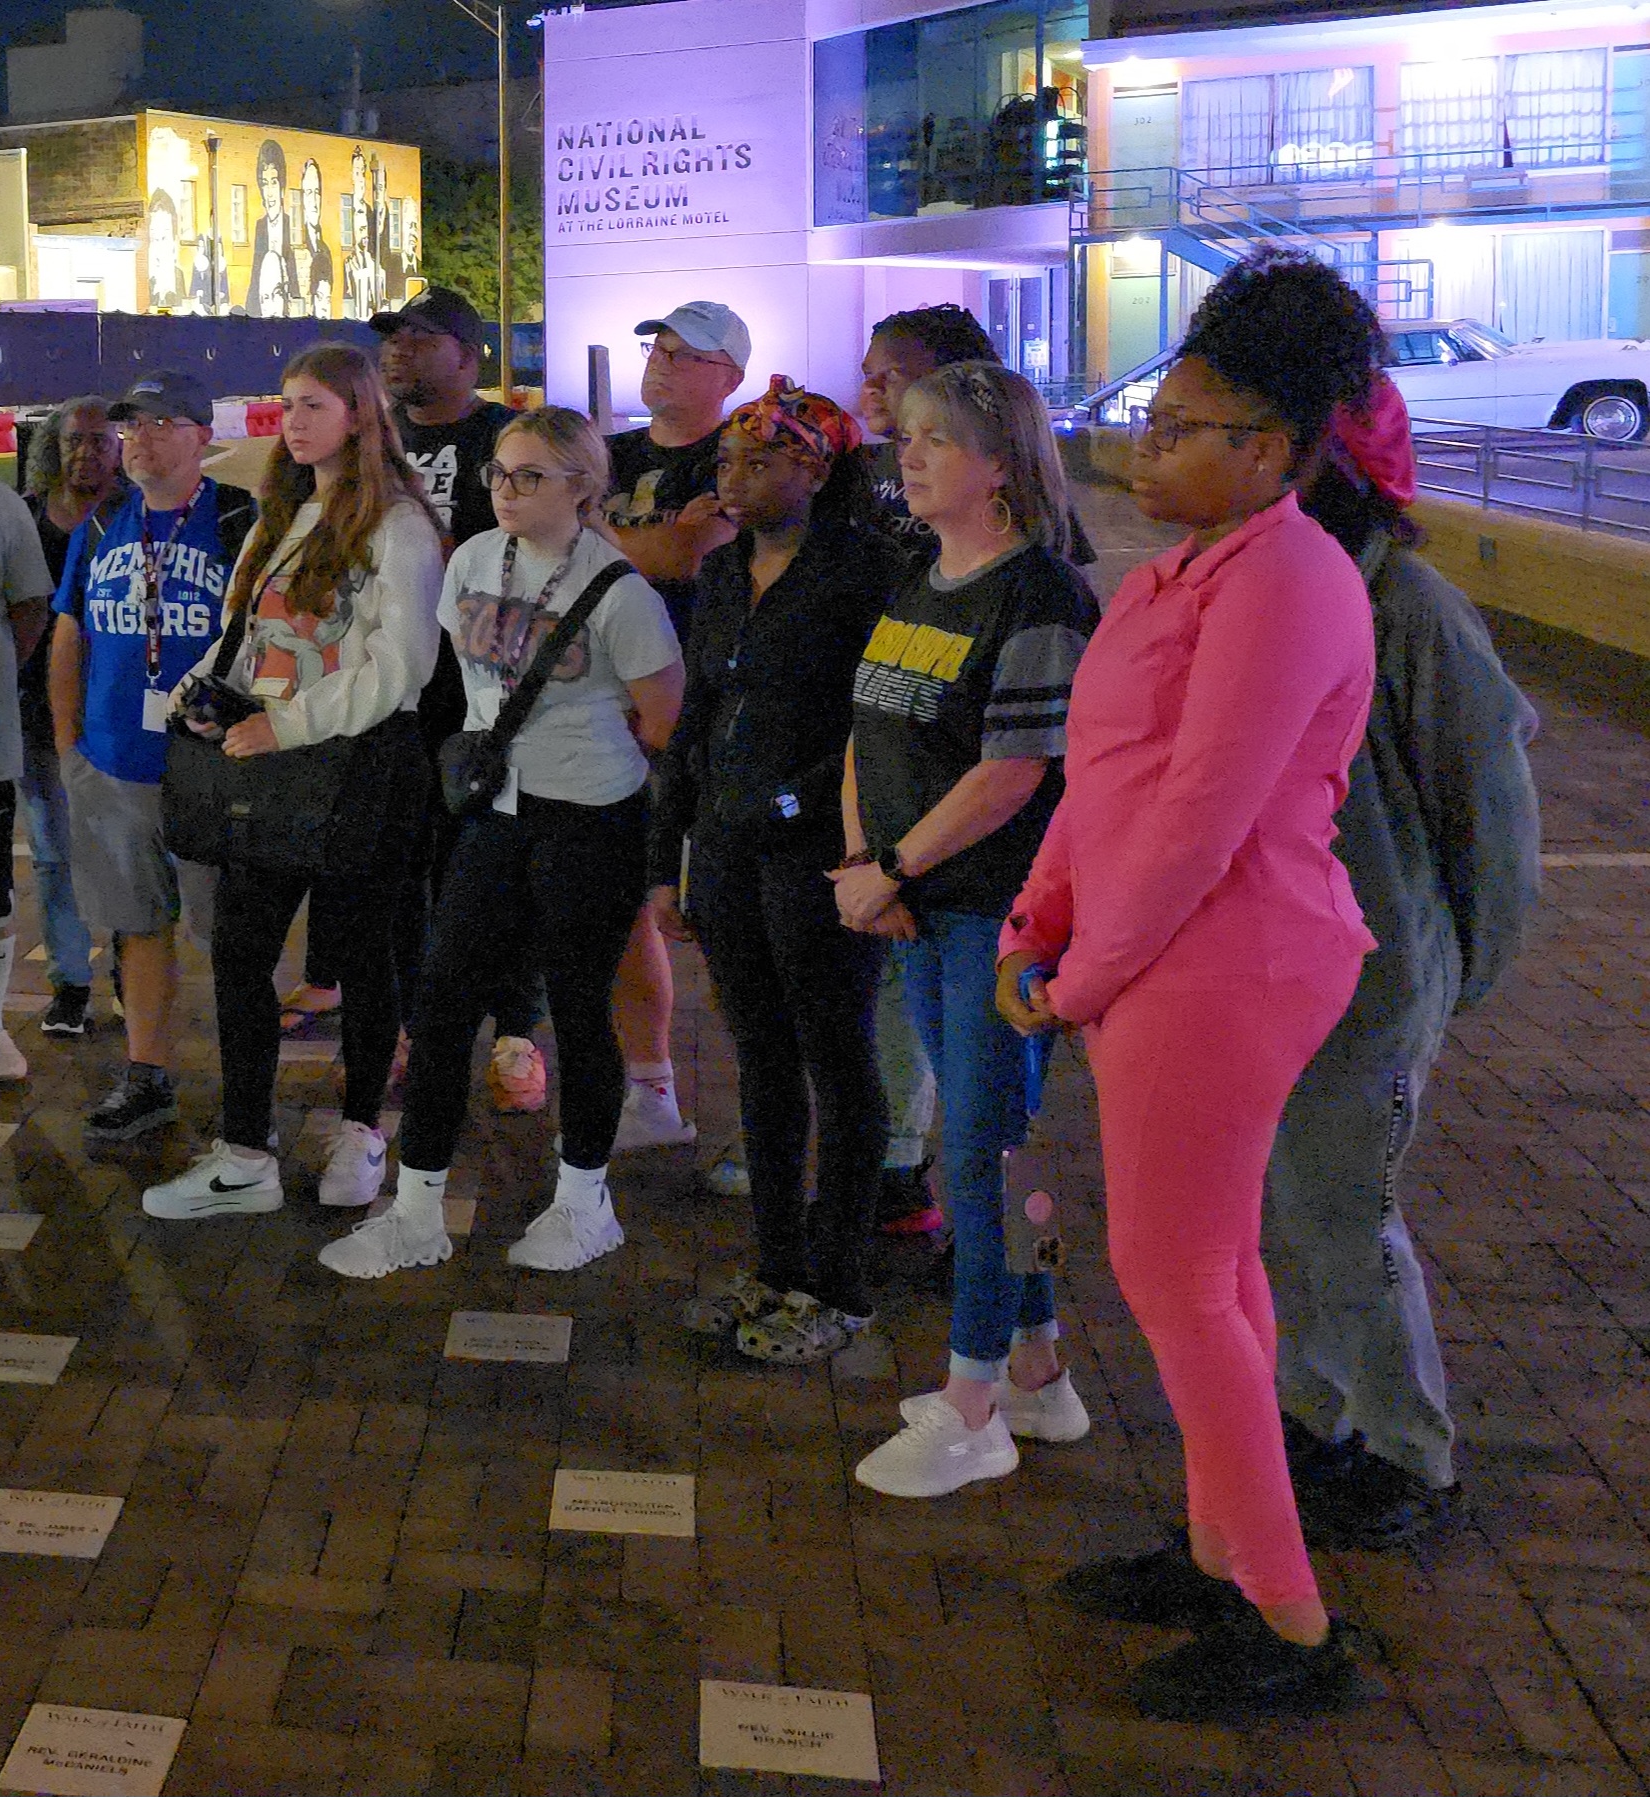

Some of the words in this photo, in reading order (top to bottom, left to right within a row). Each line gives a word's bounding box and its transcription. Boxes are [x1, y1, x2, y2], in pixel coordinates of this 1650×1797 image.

[557, 113, 706, 150] NATIONAL
[558, 154, 633, 182] CIVIL
[642, 143, 751, 176] RIGHTS
[557, 182, 688, 215] MUSEUM
[558, 221, 573, 234] AT
[578, 219, 604, 232] THE
[608, 214, 678, 230] LORRAINE
[682, 211, 730, 225] MOTEL
[177, 591, 201, 601] 1912
